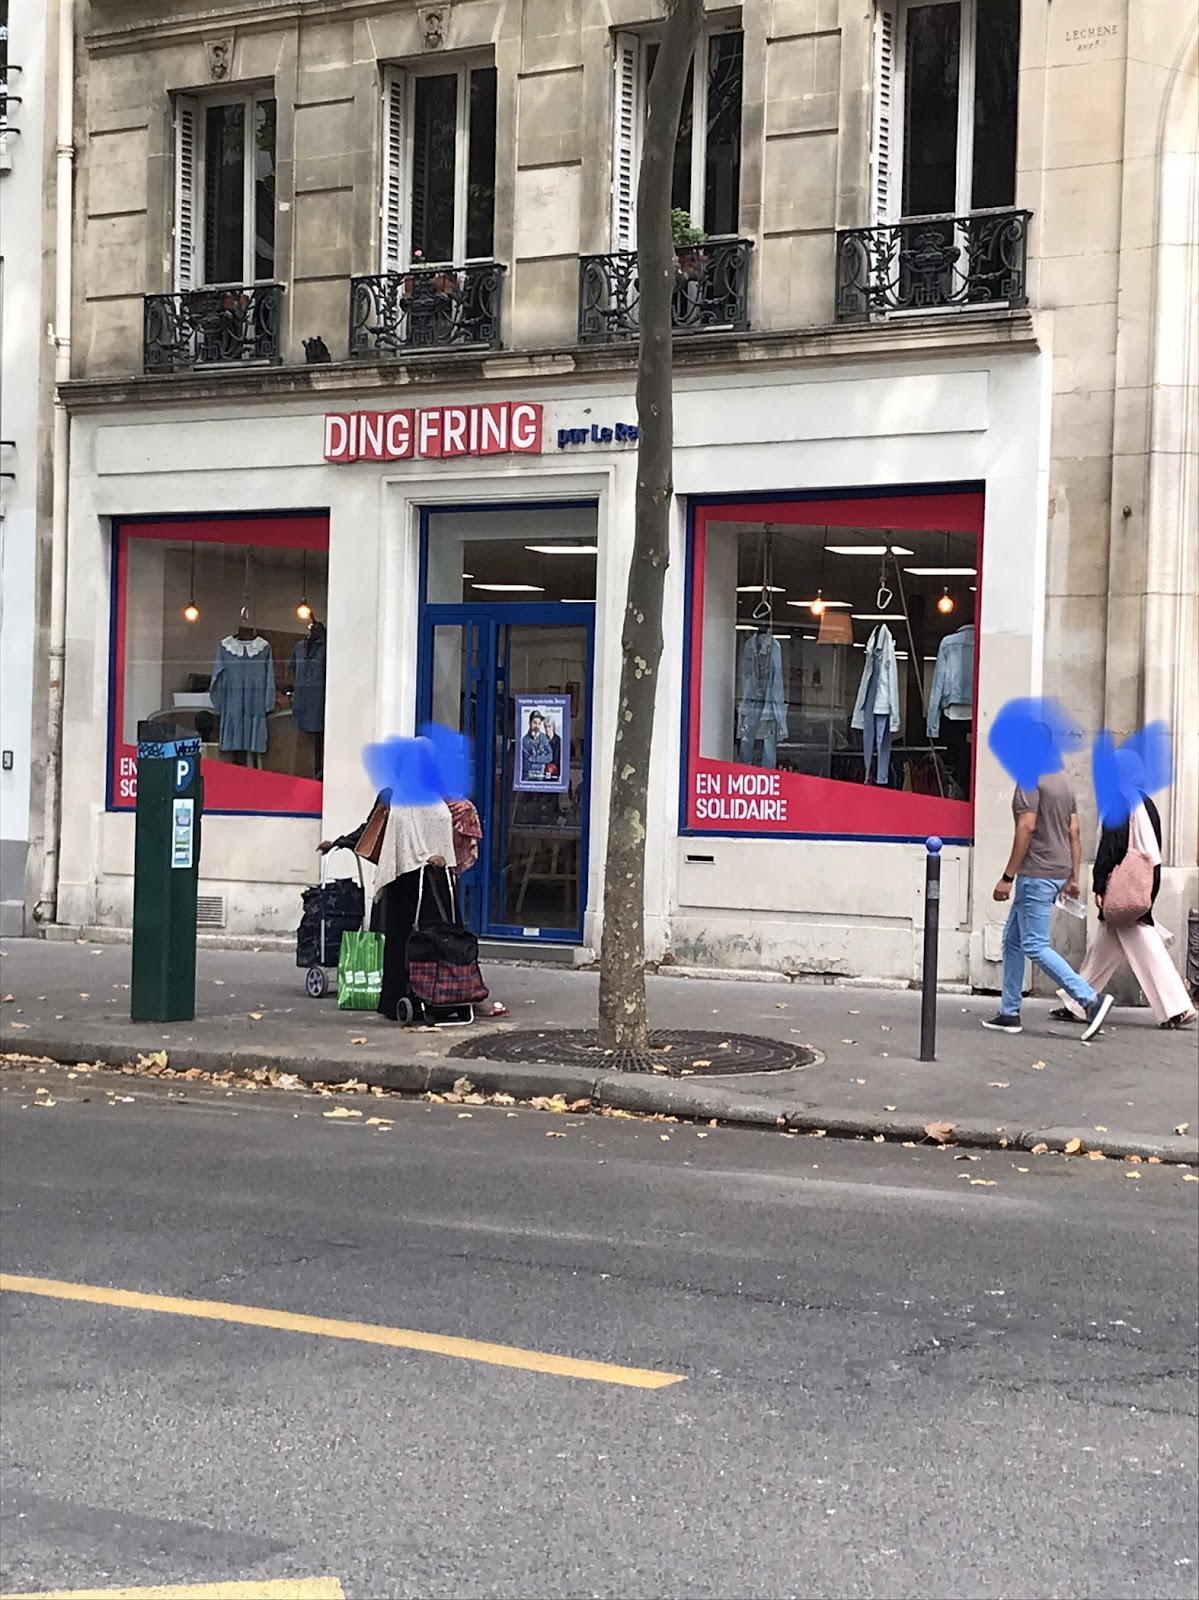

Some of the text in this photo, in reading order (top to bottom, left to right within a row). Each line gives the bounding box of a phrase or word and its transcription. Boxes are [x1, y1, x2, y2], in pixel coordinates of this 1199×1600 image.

[324, 405, 536, 457] DING FRING
[591, 423, 613, 442] Le
[177, 760, 189, 786] P
[696, 773, 780, 796] EN MODE
[696, 798, 787, 821] SOLIDAIRE
